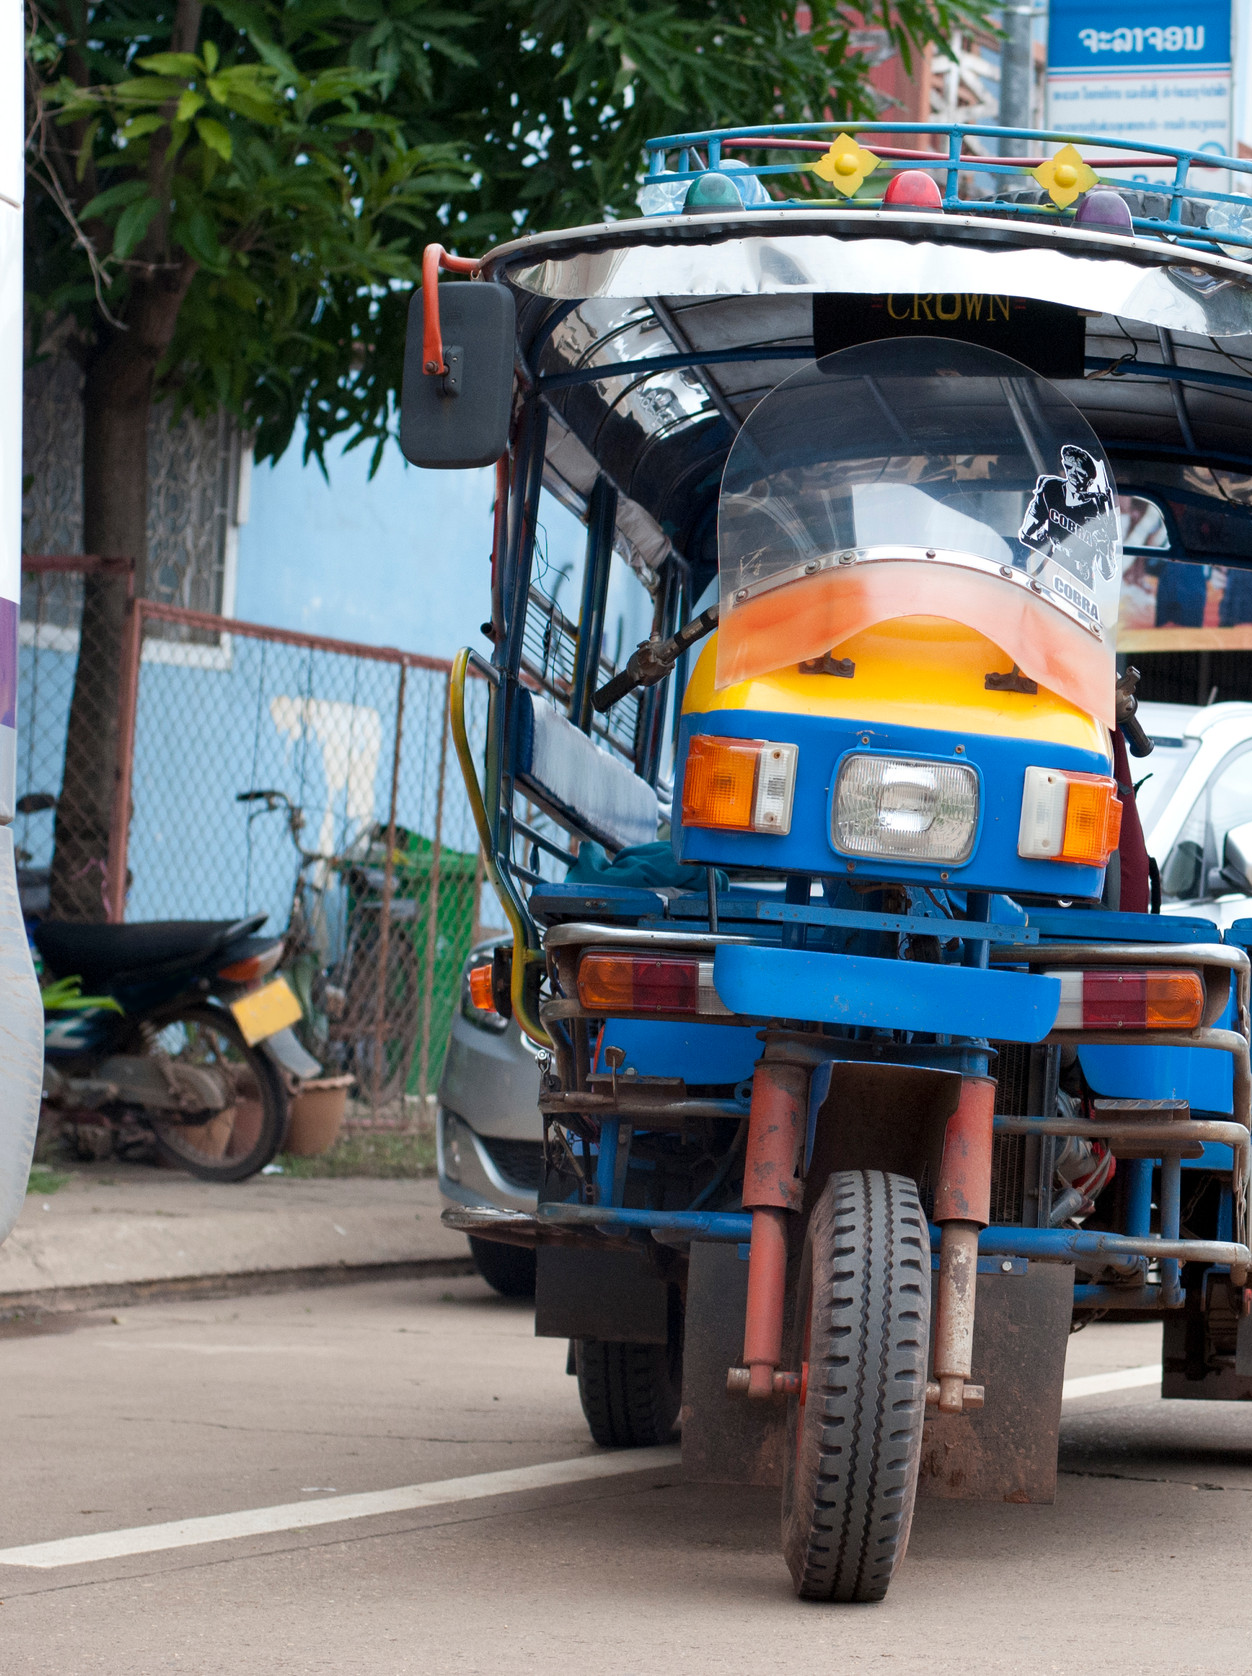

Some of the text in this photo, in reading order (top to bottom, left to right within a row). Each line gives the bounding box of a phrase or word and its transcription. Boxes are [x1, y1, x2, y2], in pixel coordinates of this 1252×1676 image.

[1078, 25, 1205, 54] ຈະລາຈອນ
[887, 293, 1010, 321] CROWN
[1049, 509, 1093, 547] COBRA
[1054, 577, 1099, 620] COBRA
